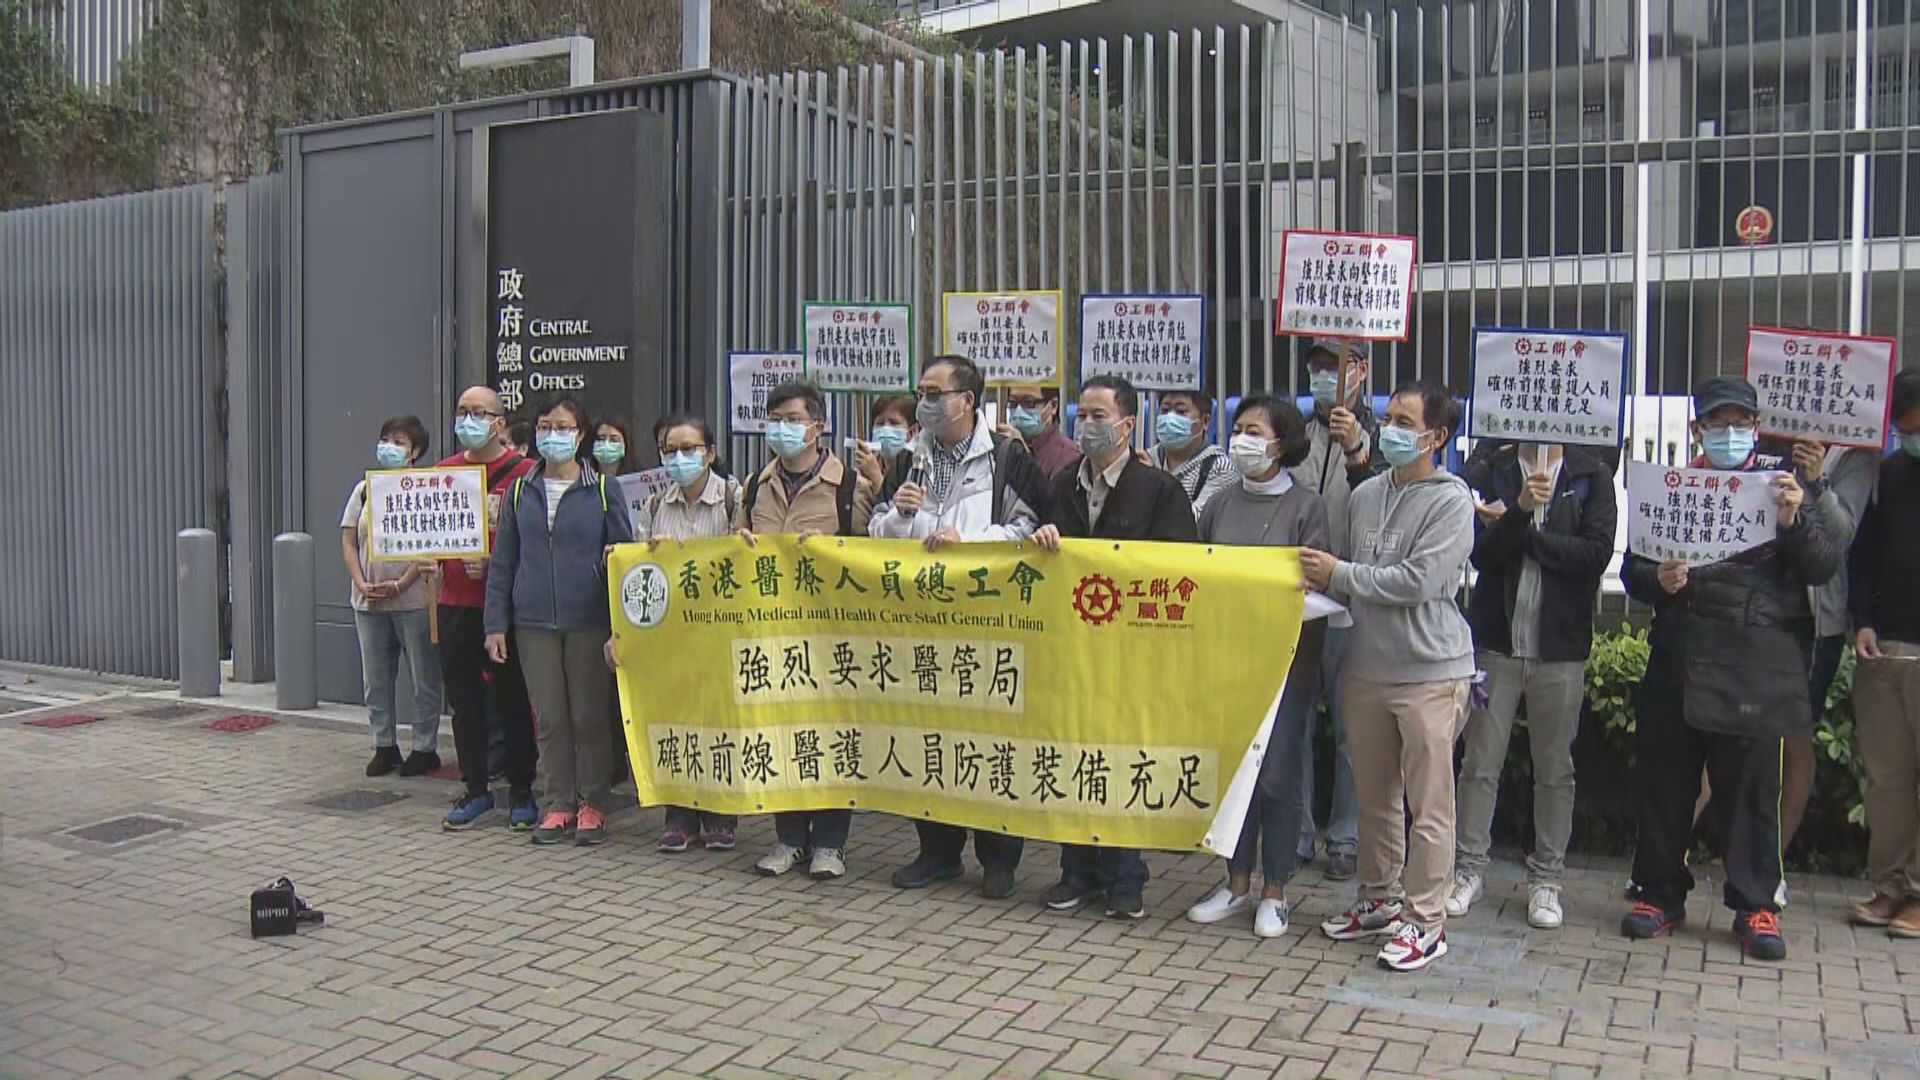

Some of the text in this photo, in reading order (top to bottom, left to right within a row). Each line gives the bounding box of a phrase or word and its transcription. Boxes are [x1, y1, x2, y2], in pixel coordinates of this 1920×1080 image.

[498, 268, 524, 410] 政府總部
[1534, 340, 1588, 359] 工聯會
[1518, 360, 1578, 377] 強烈要求
[1784, 360, 1843, 380] 強烈要求
[1488, 374, 1610, 399] 確保前線醫護人員
[1758, 374, 1875, 401] 確保前線醫護人員
[1500, 394, 1592, 415] 防護裝備充足
[1768, 392, 1857, 417] 防護裝備充足
[1685, 476, 1743, 494] 工聯會
[1668, 491, 1733, 511] 強烈要求
[1640, 502, 1766, 528] 確保前線醫護人員
[1651, 521, 1748, 544] 防護裝備充足
[678, 555, 1045, 605] 香港醫療人員總工會
[1127, 576, 1199, 603] 工聯會
[683, 606, 1044, 632] Hong Kong Medical and Health Care Staff General Union
[739, 640, 1019, 706] 強烈要求醫管局
[656, 729, 1211, 811] 確保前線醫護人員防護裝備充足
[257, 908, 288, 919] MIPRO
